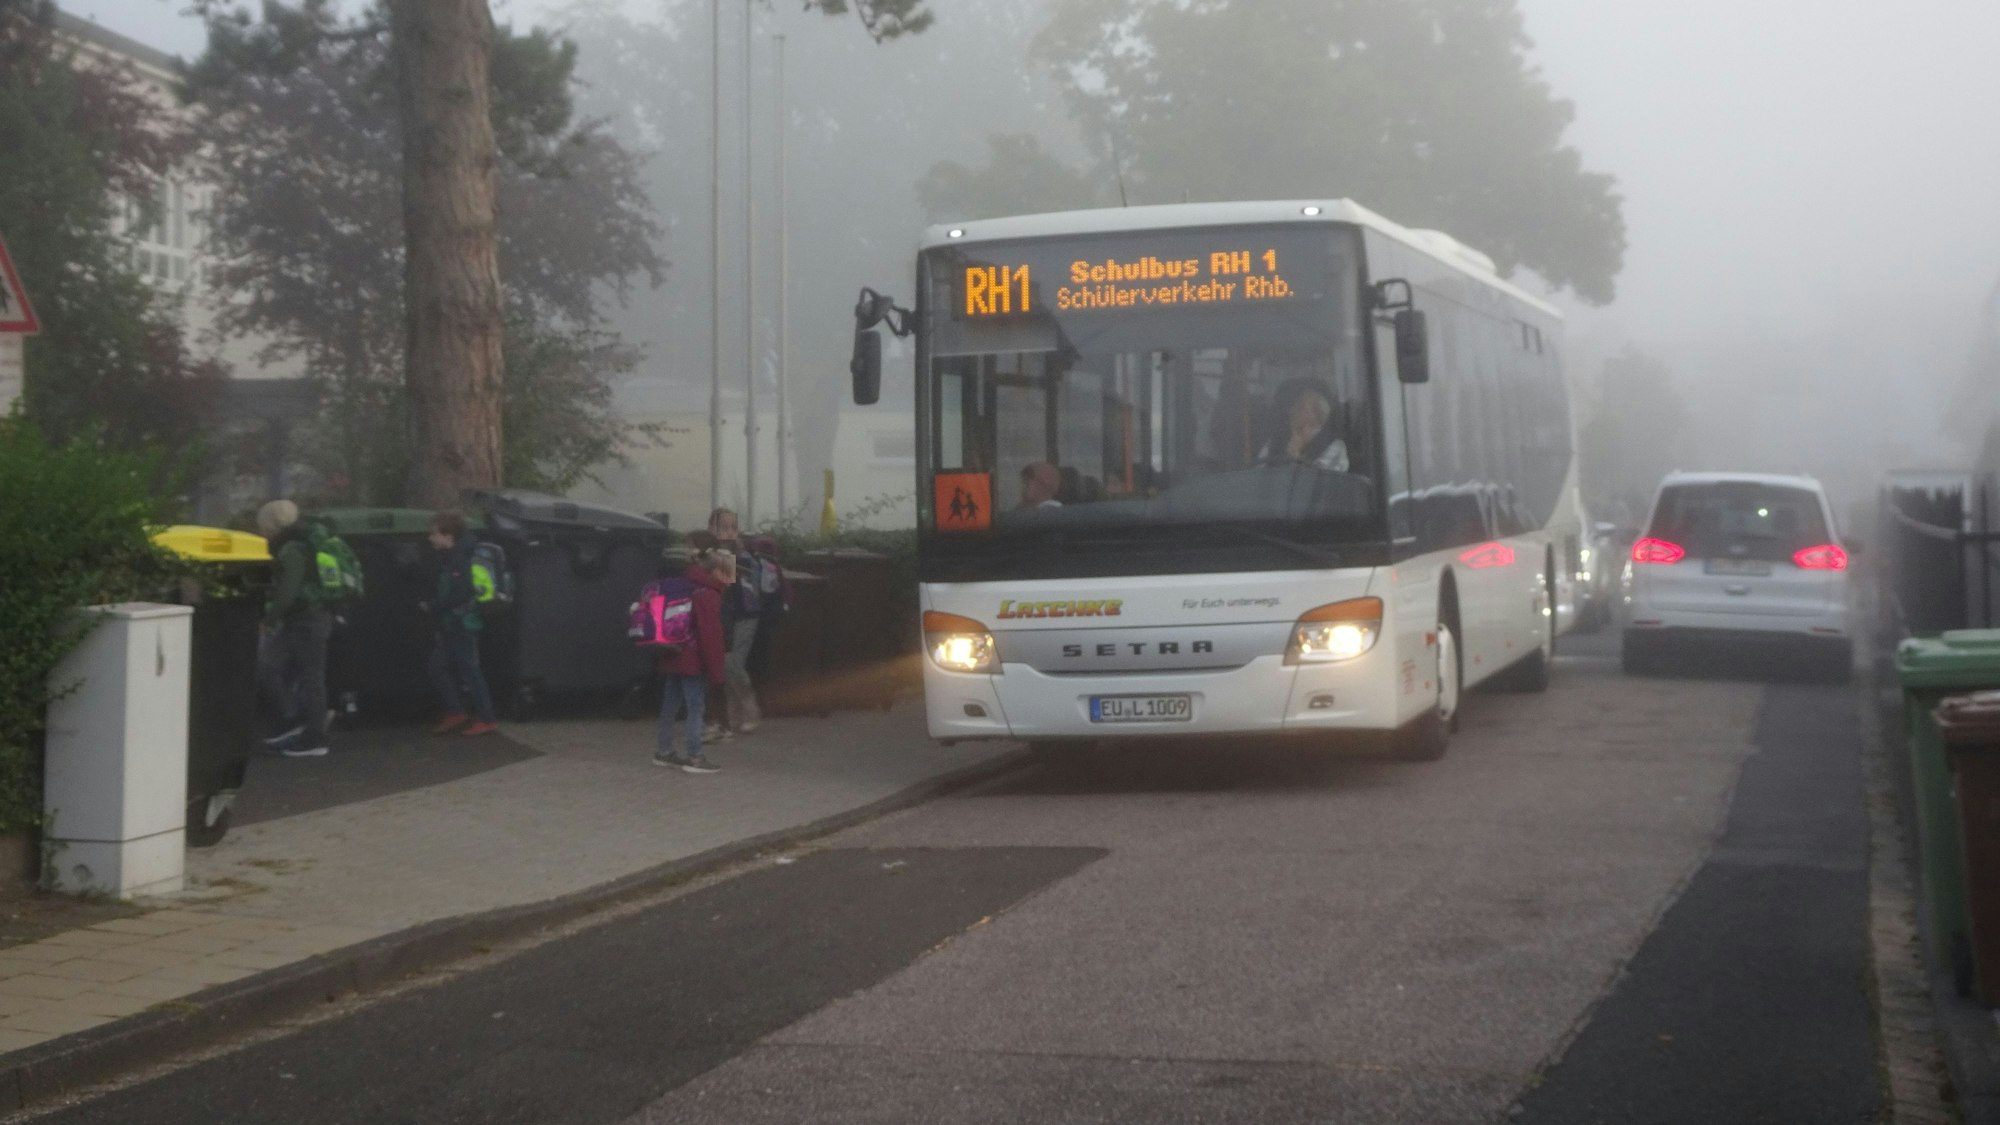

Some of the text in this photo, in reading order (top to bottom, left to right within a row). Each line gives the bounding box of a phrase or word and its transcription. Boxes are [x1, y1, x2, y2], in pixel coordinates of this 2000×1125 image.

[1070, 248, 1277, 284] Schulbus RH 1
[966, 264, 1030, 315] RH1
[1056, 274, 1295, 311] Schülerverkehr Rhb.
[1181, 598, 1199, 609] Für
[1200, 597, 1225, 609] Euch
[1062, 640, 1214, 658] SETRA
